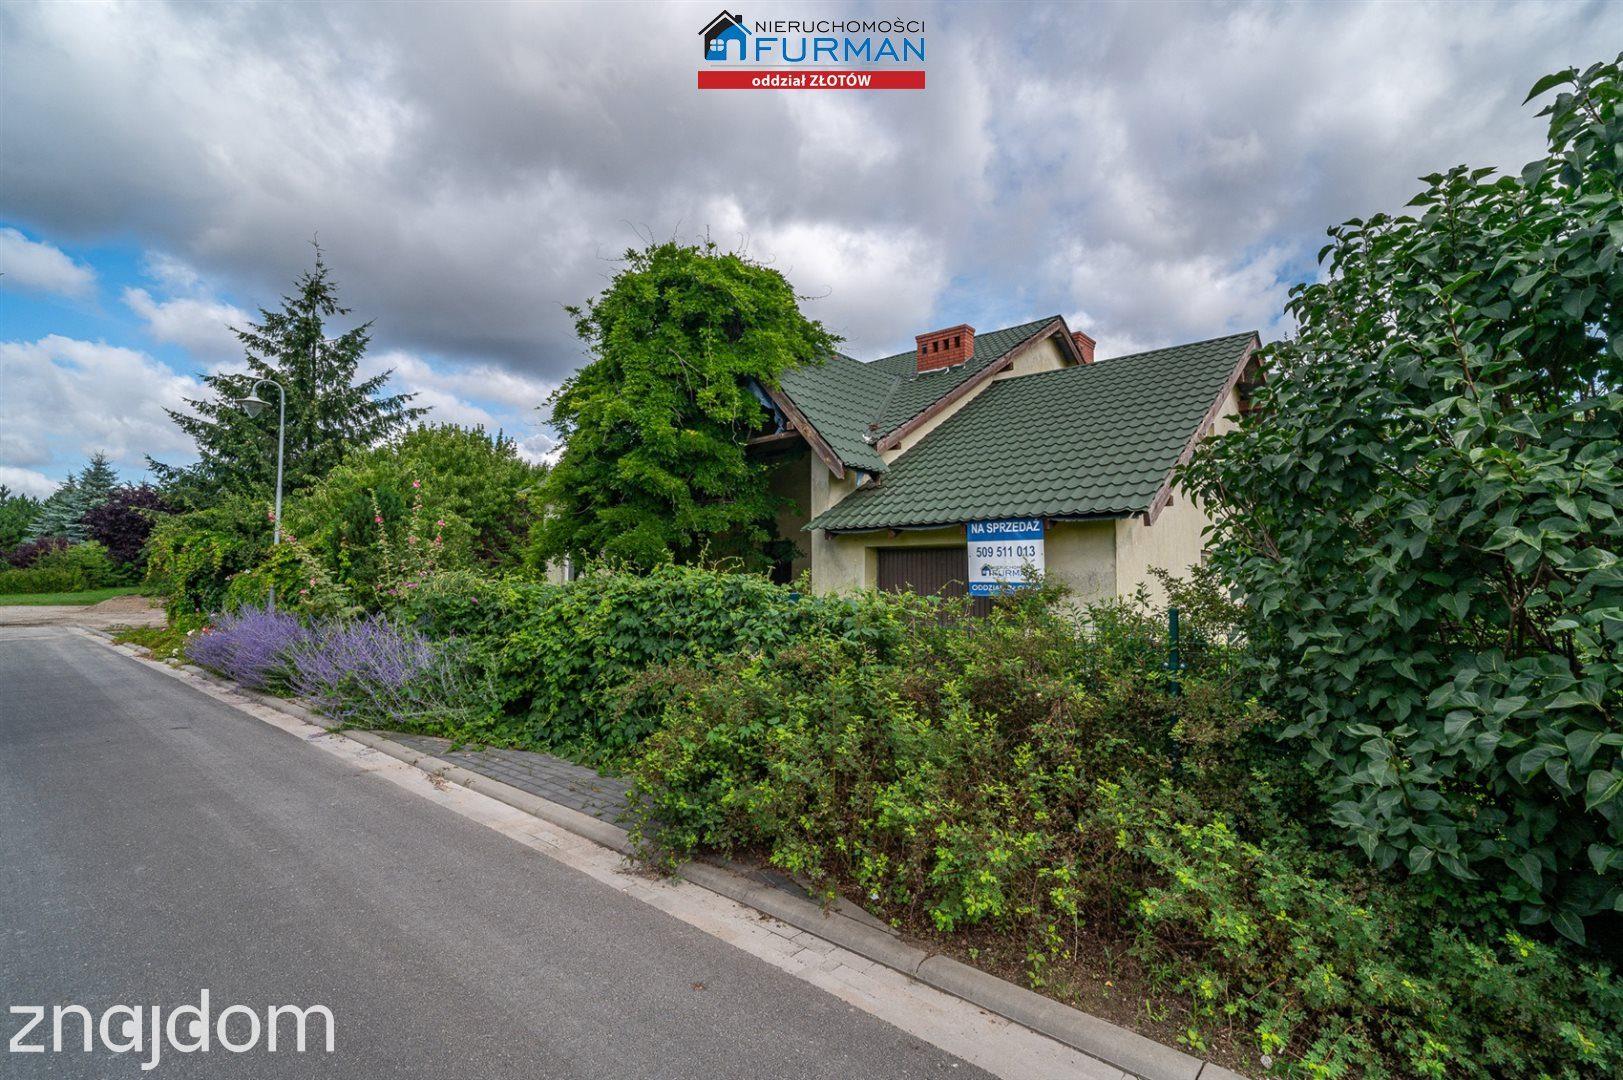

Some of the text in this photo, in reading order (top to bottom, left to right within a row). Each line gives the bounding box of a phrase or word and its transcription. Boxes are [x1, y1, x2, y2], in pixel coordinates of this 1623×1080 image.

[971, 519, 1040, 534] NA SPRZEDAŻ
[976, 545, 1036, 558] 509 511 013
